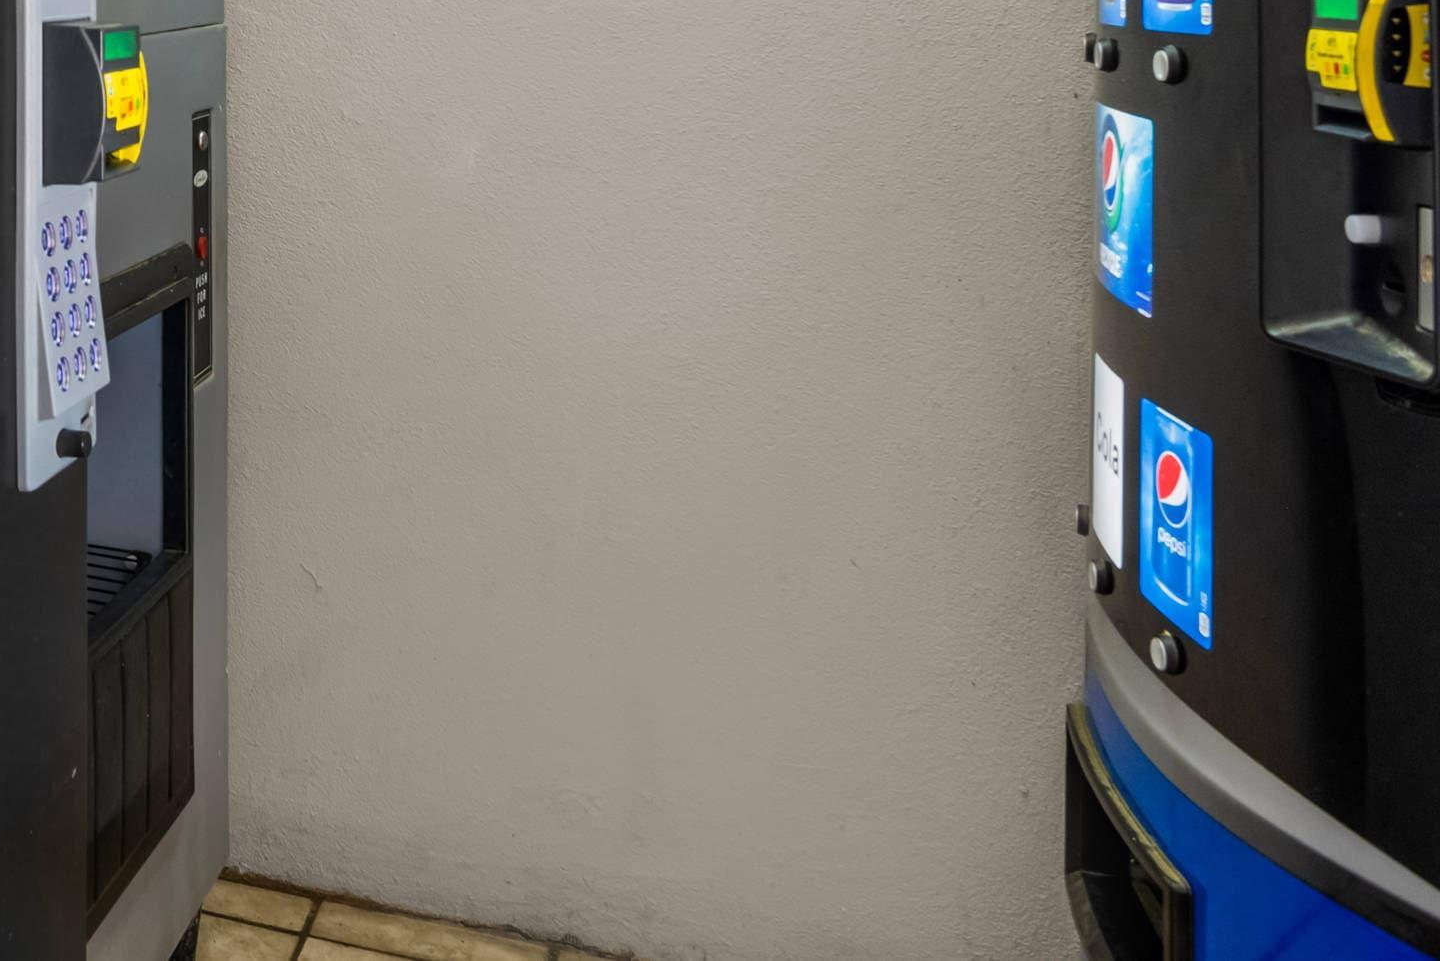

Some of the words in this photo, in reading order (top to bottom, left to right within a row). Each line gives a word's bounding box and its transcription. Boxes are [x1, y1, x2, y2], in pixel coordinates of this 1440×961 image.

[195, 271, 208, 289] PUSH
[197, 288, 207, 305] FOR
[197, 305, 206, 321] ICE
[1095, 411, 1120, 477] Cola
[1157, 527, 1187, 557] pepsi
